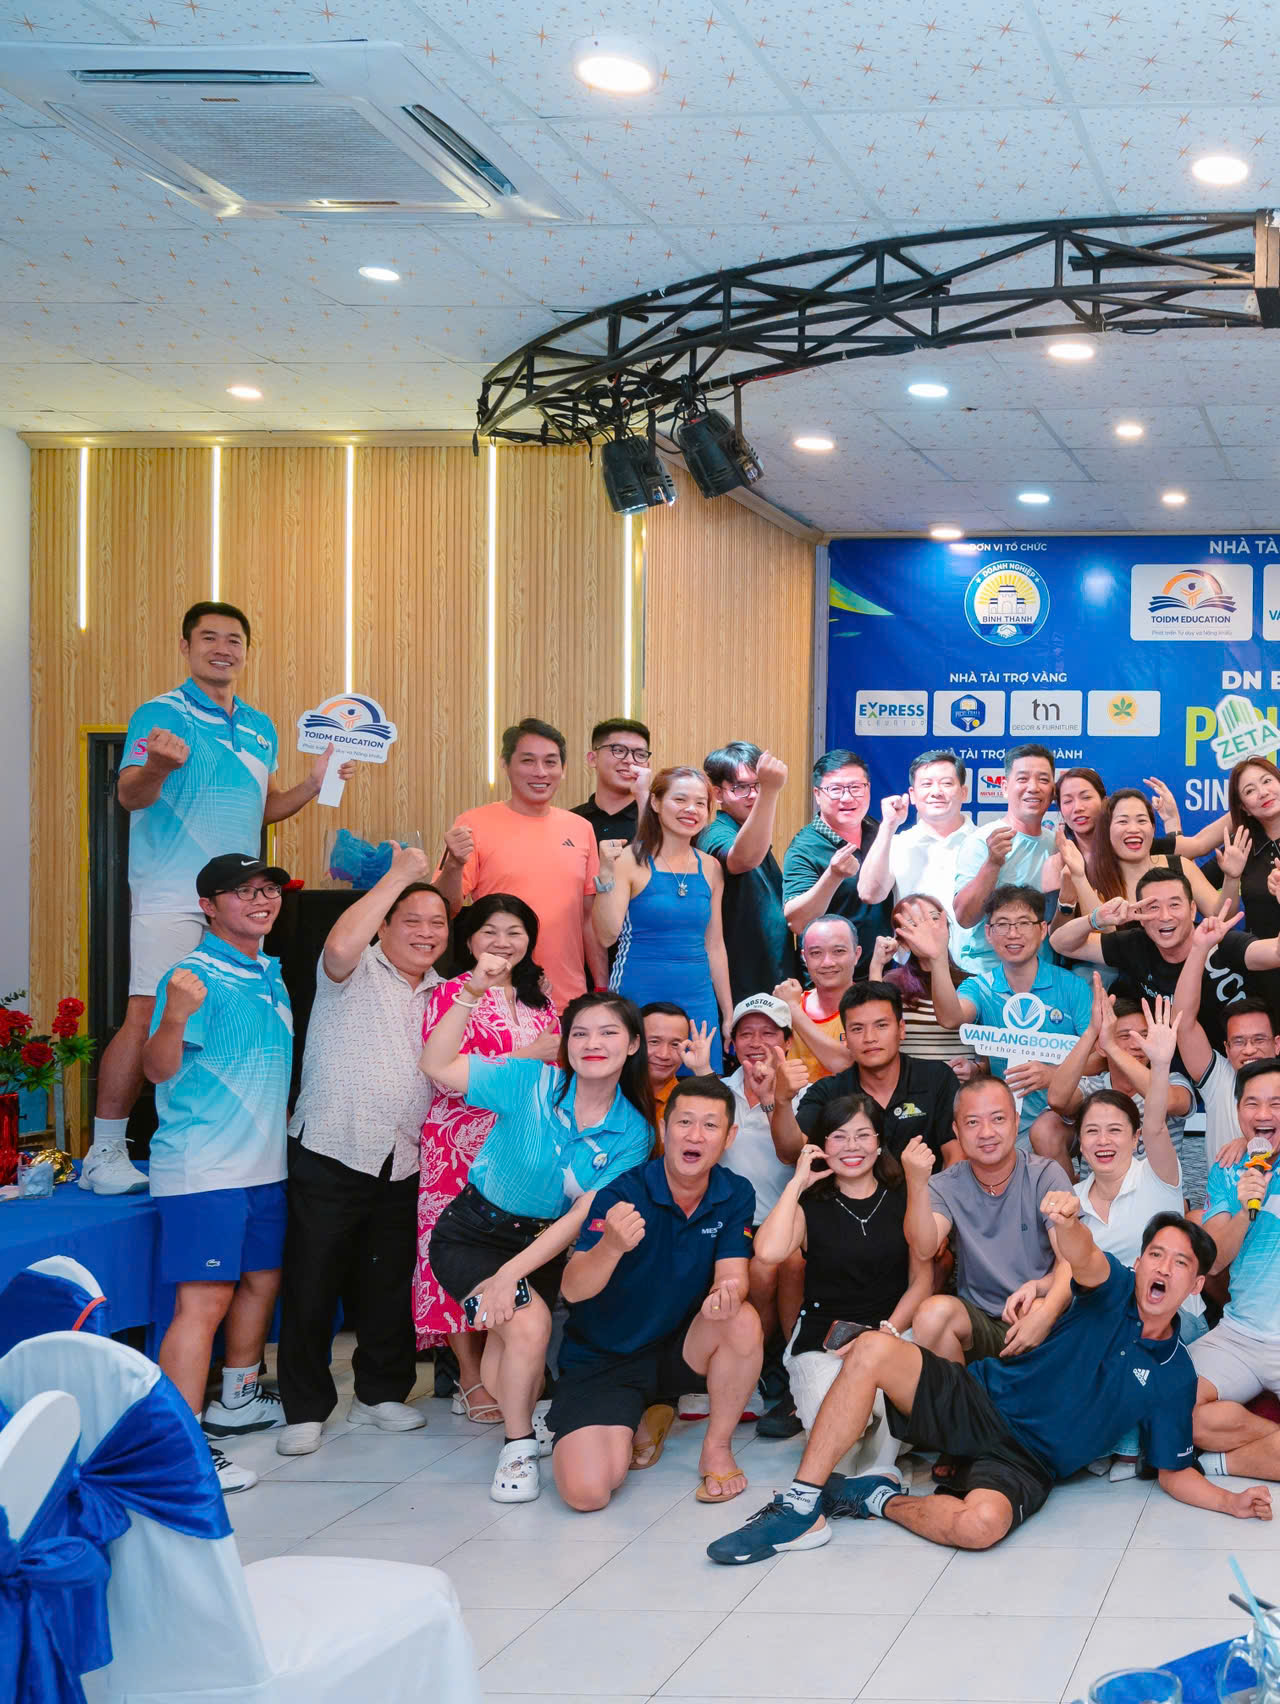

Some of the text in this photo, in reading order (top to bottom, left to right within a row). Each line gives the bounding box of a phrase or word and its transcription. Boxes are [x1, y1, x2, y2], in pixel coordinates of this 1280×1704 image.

[1020, 542, 1047, 551] CHỨC
[1209, 537, 1251, 554] NHÀ
[982, 563, 1008, 577] DOANH
[1151, 615, 1231, 624] TOIDM EDUCATION
[949, 671, 1067, 684] NHÀ TÀI TRỢ VÀNG
[1221, 670, 1262, 690] DN
[859, 702, 925, 718] EXPRESS
[304, 730, 384, 749] TOIDM EDUCATION
[1217, 724, 1278, 759] ZETA
[960, 747, 978, 759] TÀI
[981, 748, 1006, 761] TRỢ
[1185, 778, 1230, 811] SIN
